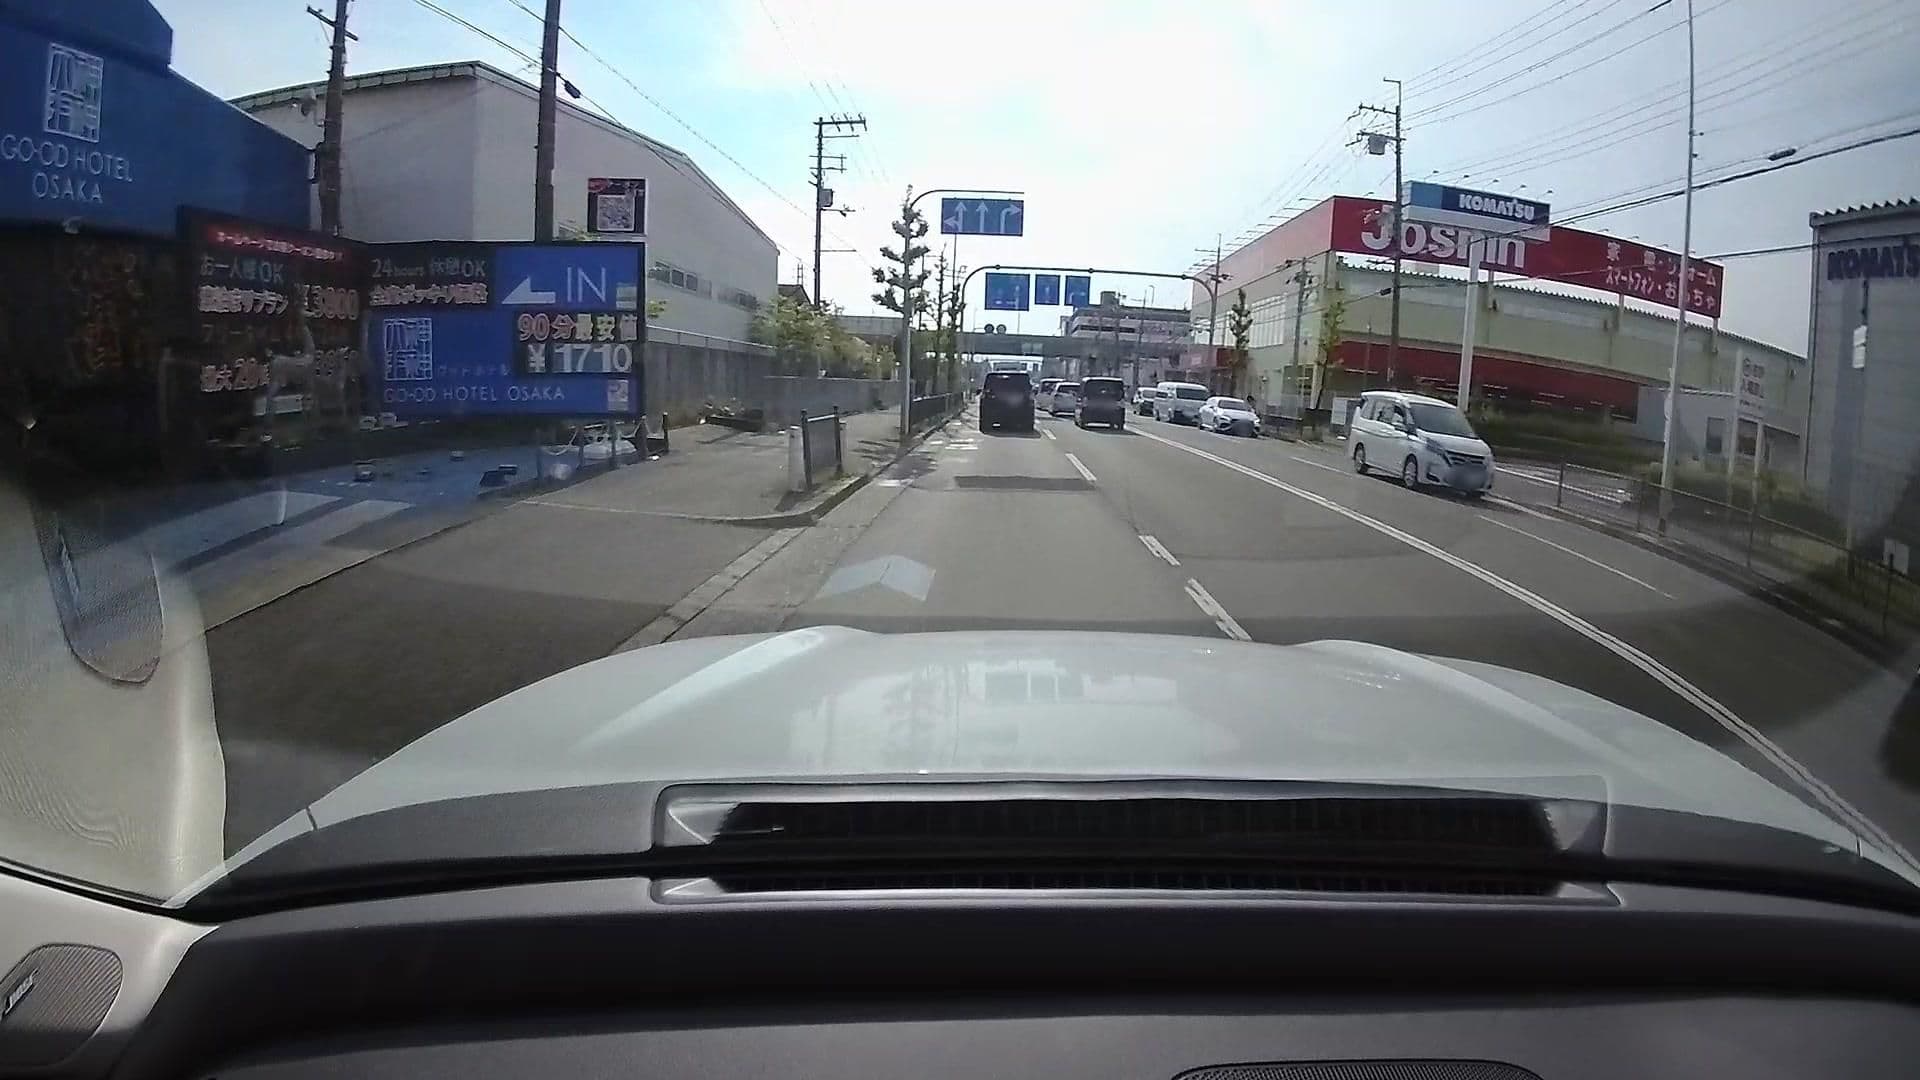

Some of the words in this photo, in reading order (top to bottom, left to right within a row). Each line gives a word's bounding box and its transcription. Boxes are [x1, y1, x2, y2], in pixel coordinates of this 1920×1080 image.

[75, 151, 133, 182] HOTEL
[32, 172, 104, 203] OSAKA
[1459, 193, 1535, 221] KOMATSU
[567, 267, 607, 303] IN
[1605, 266, 1716, 311] スマートフォン・おちゃ
[443, 386, 497, 402] HOTEL
[508, 385, 565, 402] OSAKA
